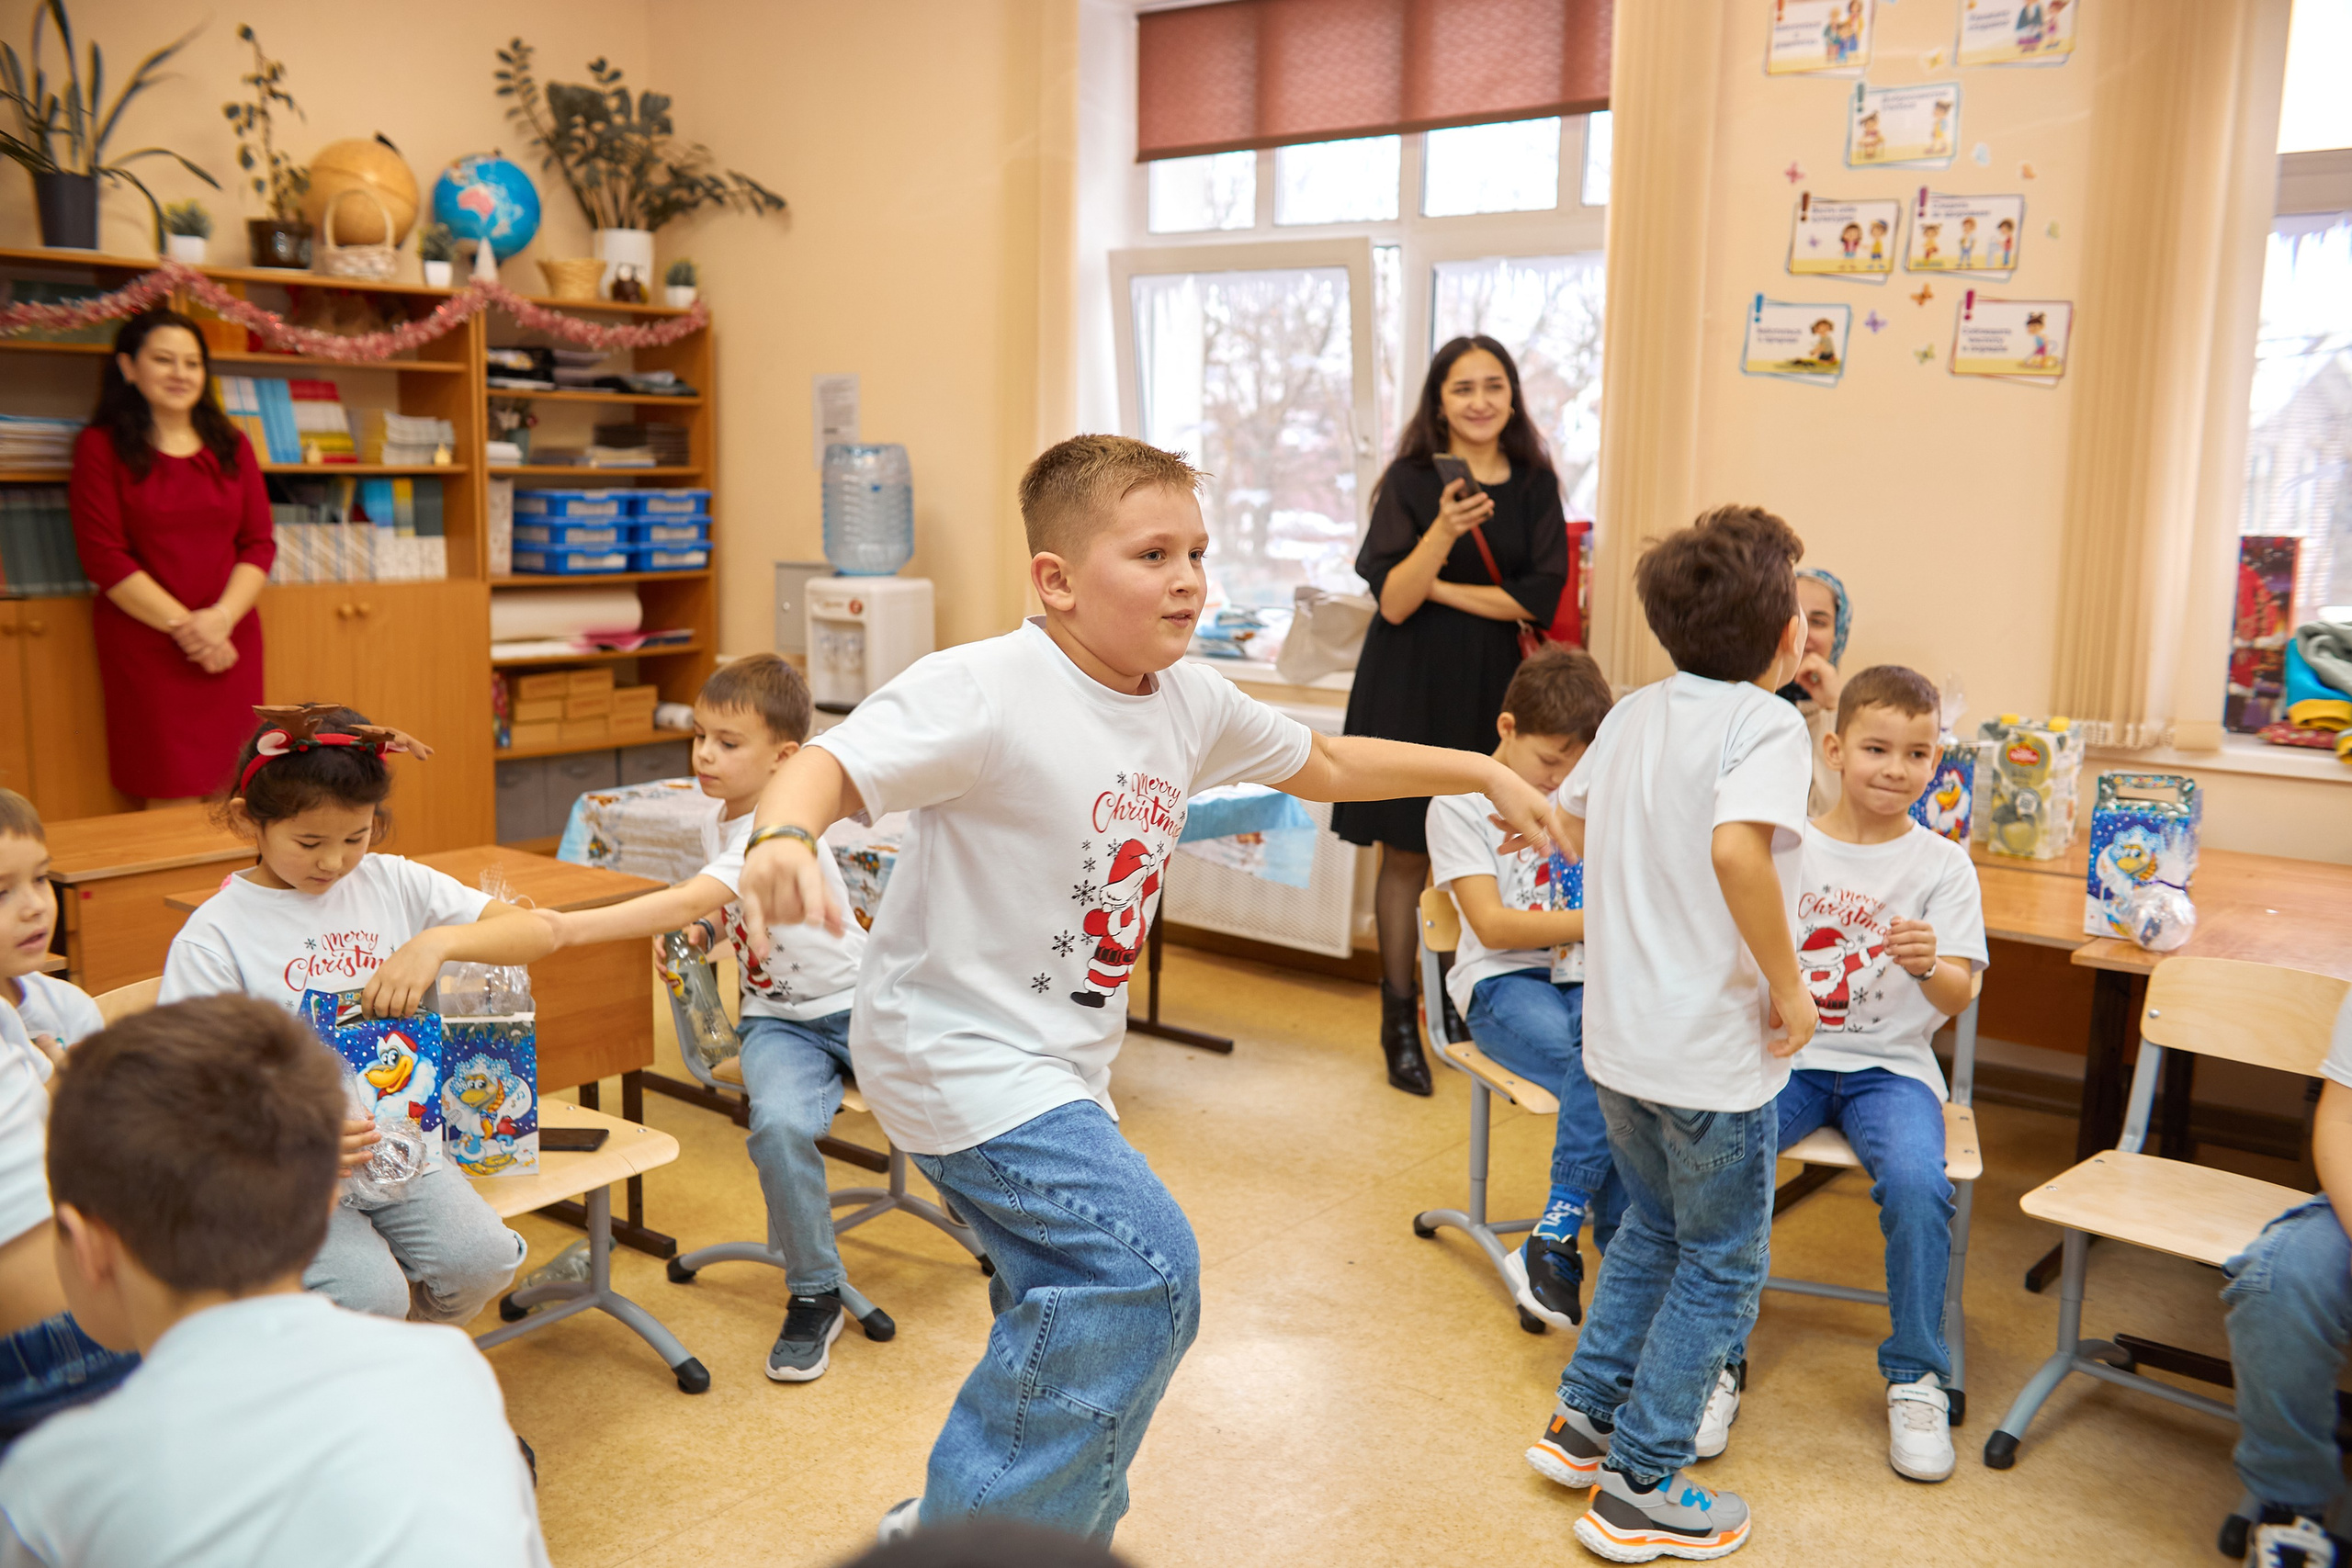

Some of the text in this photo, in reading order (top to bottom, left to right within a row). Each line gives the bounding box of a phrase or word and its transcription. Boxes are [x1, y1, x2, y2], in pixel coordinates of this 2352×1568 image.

[1131, 773, 1182, 808] Merry
[1092, 791, 1182, 838] Christm
[1798, 892, 1888, 936] Christma
[1834, 888, 1887, 917] Merry
[321, 930, 379, 952] Merry
[284, 944, 384, 992] Christm
